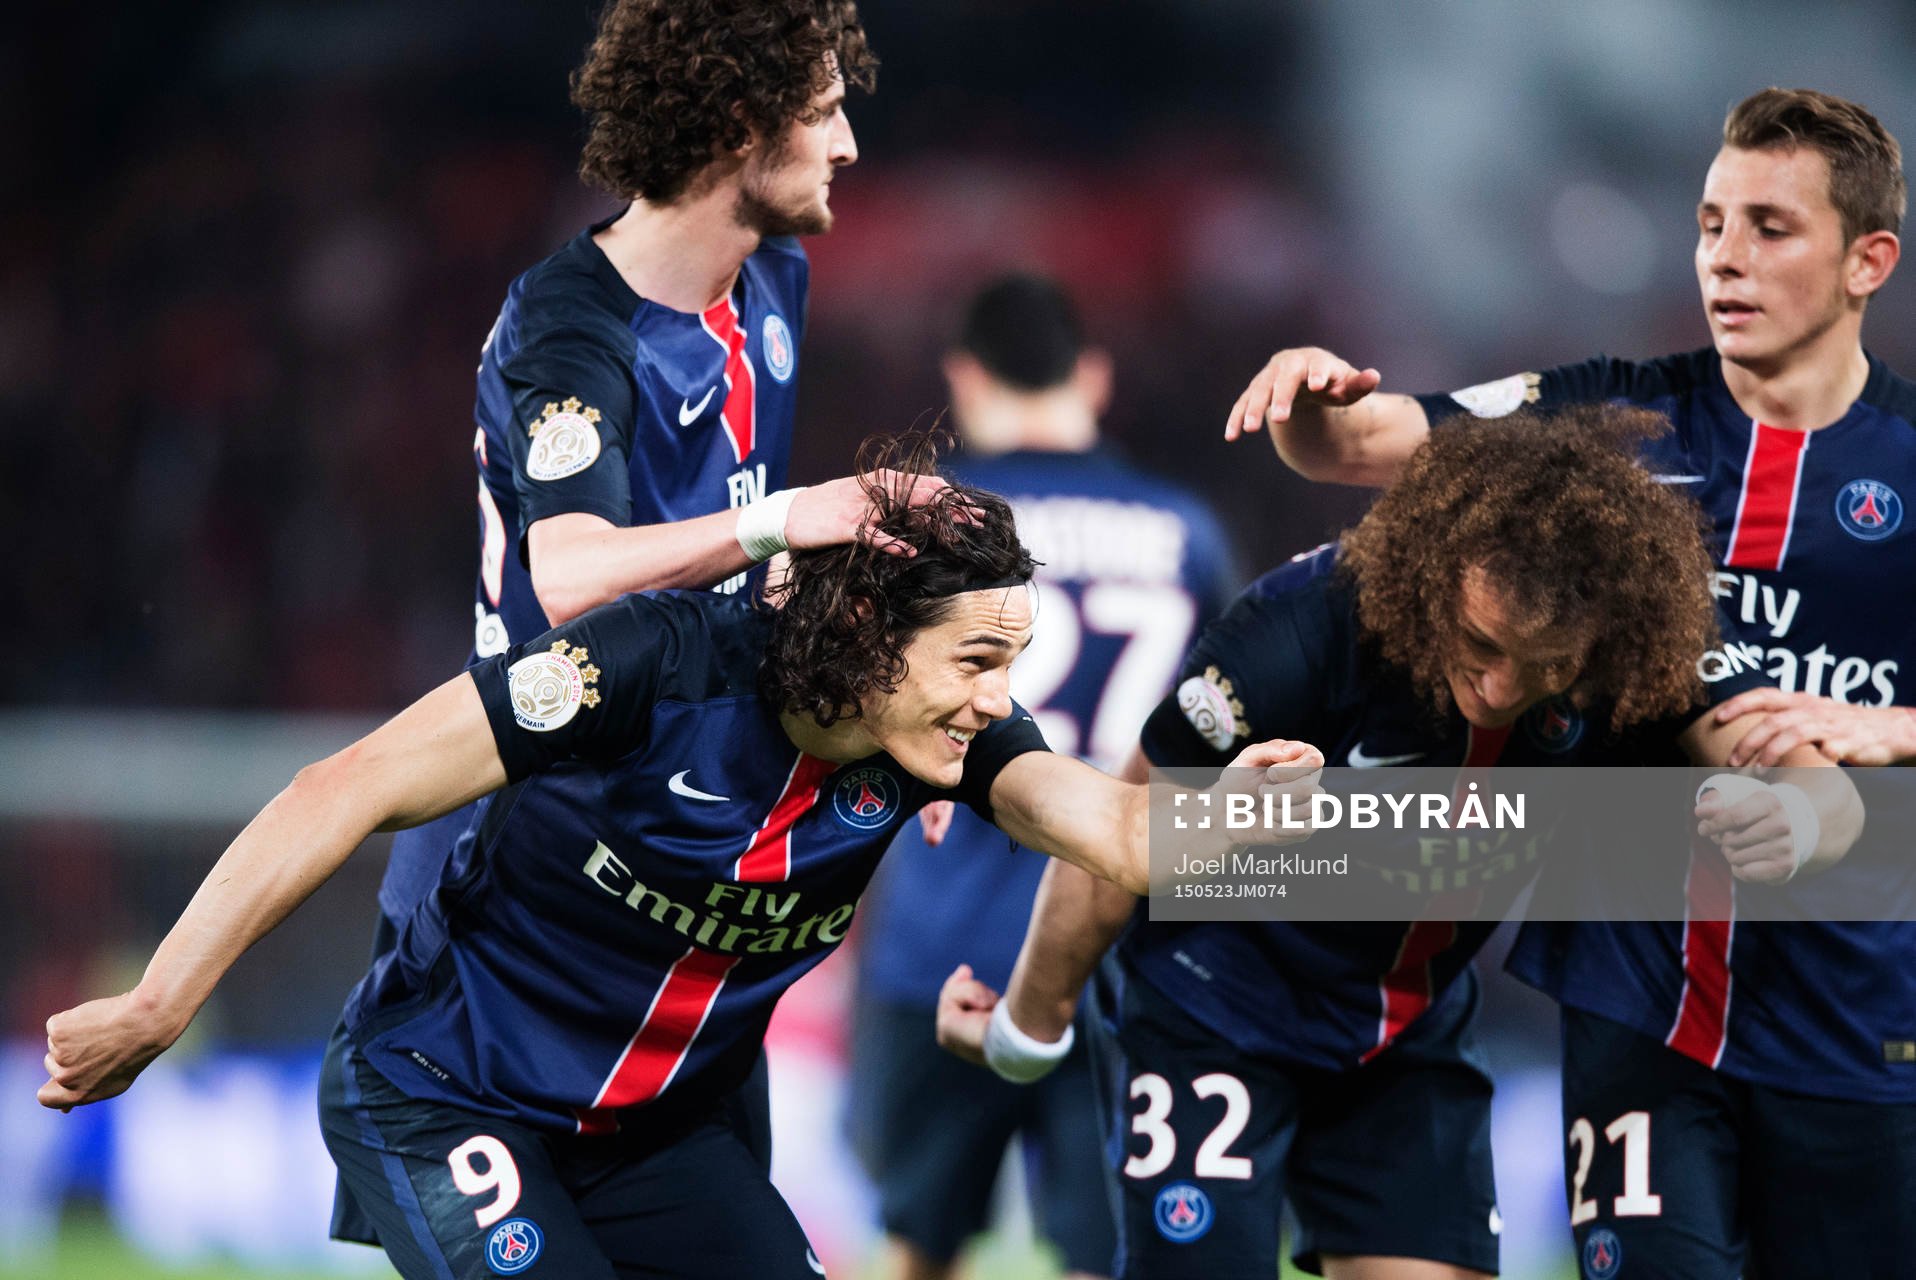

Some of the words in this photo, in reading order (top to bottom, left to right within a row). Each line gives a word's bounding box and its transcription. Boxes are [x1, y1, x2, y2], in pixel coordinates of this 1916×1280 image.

[1706, 571, 1800, 638] Fly
[514, 712, 546, 729] GERMAIN
[841, 769, 885, 790] PARIS
[582, 839, 861, 953] Emirate
[704, 882, 801, 923] Fly
[1123, 1072, 1252, 1179] 32
[447, 1135, 522, 1229] 9
[1568, 1111, 1662, 1226] 21
